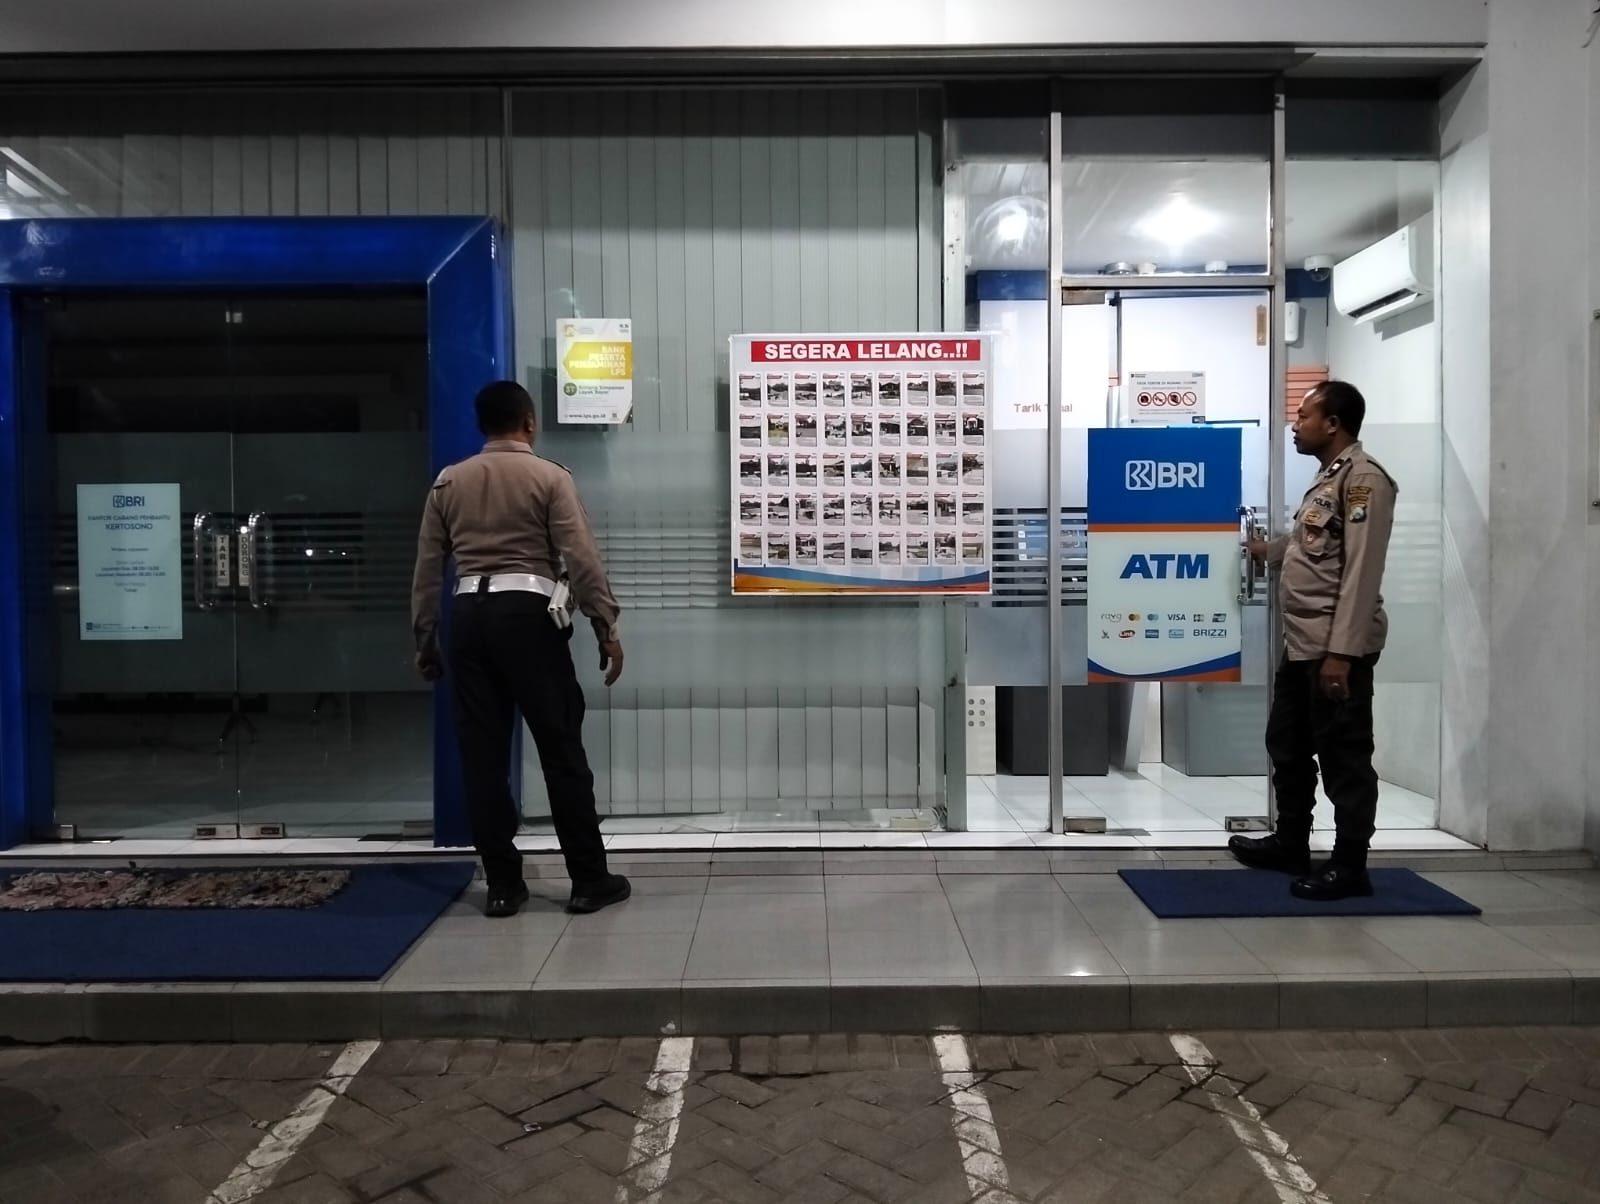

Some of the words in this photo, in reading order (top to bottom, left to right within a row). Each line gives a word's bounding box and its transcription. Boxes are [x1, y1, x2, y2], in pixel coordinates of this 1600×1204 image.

[588, 353, 626, 361] PESERTA
[764, 343, 851, 360] SEGERA
[857, 342, 969, 360] LELANG..!!
[610, 368, 626, 376] LPS
[1013, 403, 1042, 413] Tarik
[1157, 462, 1205, 488] BRI
[125, 495, 145, 507] BRI
[219, 535, 227, 577] TARIK
[241, 536, 249, 577] DORONG
[1119, 554, 1209, 580] ATM
[1167, 613, 1186, 622] VISA
[1192, 628, 1228, 640] BRIZZI
